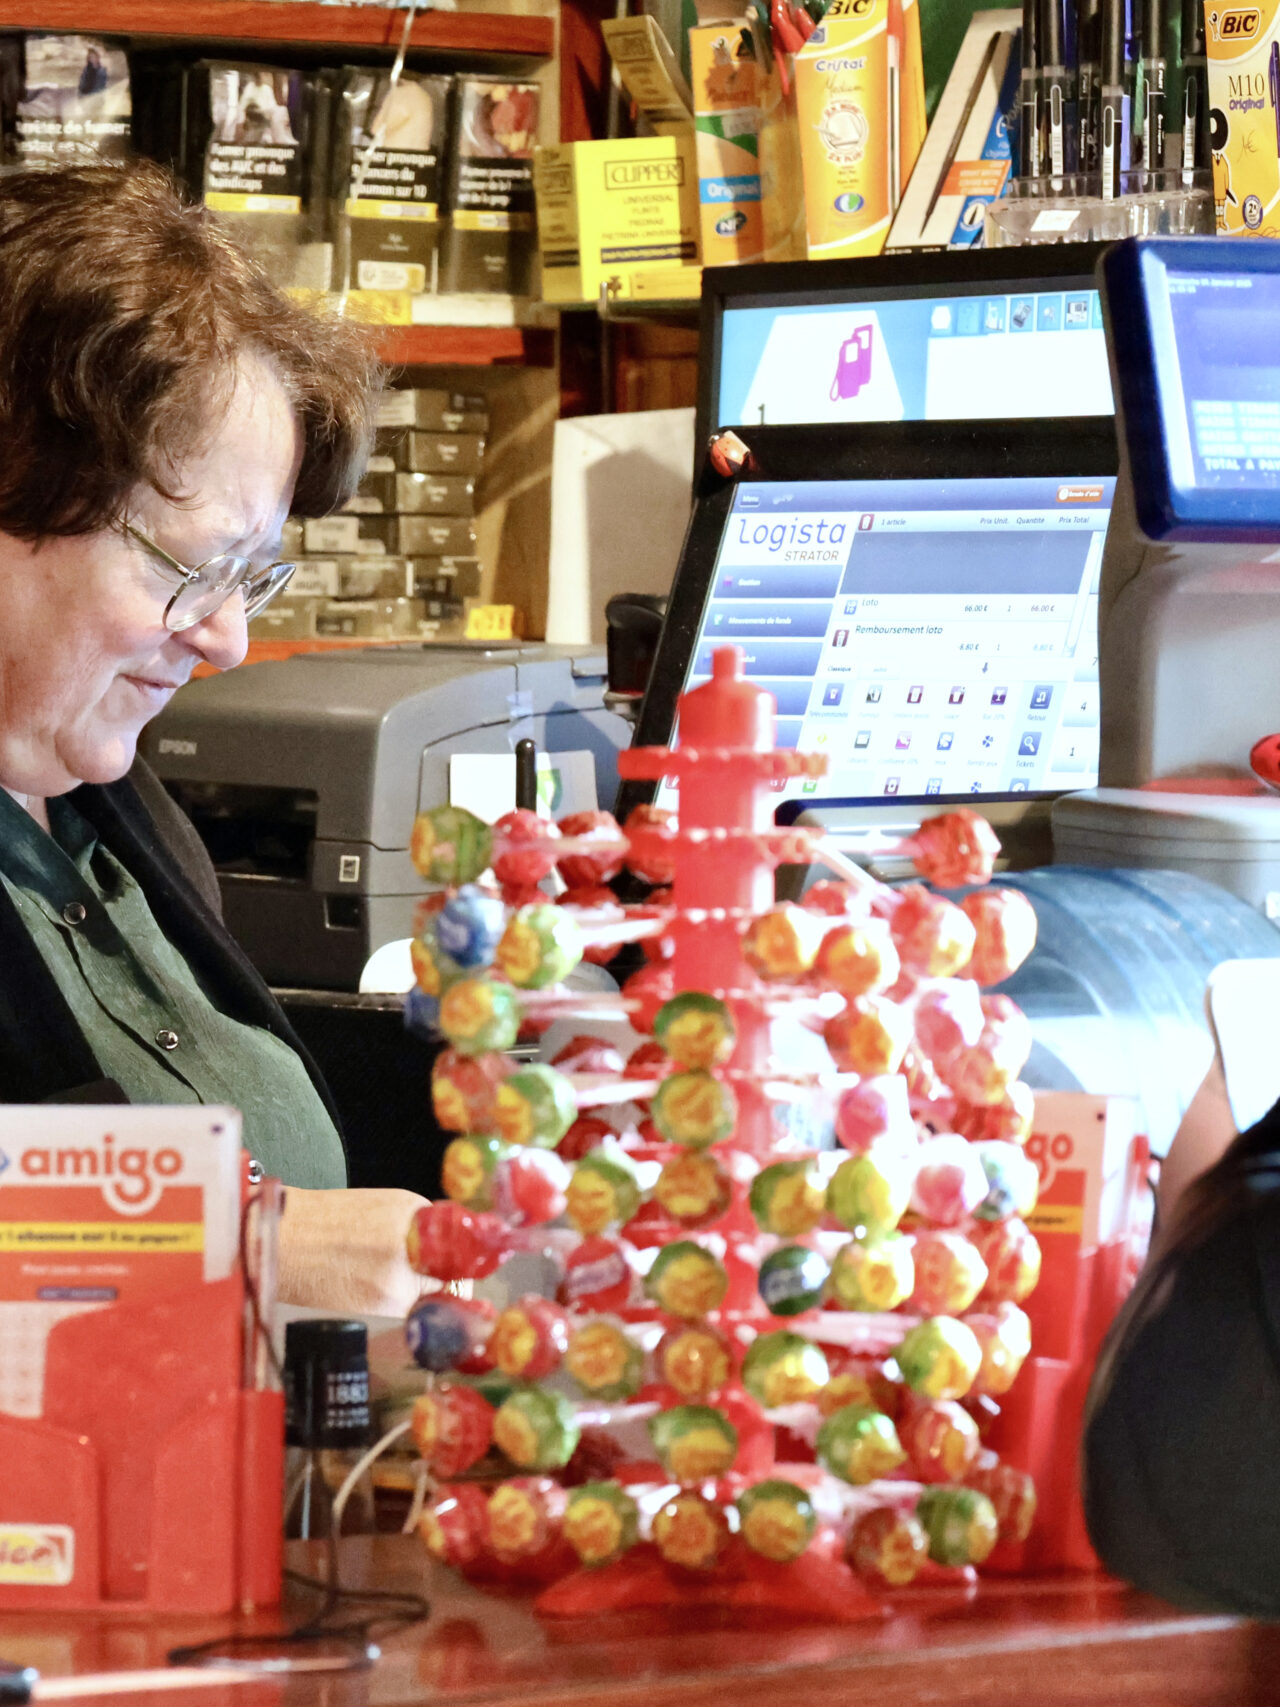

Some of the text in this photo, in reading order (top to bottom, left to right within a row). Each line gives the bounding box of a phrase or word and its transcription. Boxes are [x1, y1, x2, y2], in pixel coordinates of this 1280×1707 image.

[815, 58, 865, 72] Cristal
[1228, 72, 1265, 97] M10
[1229, 98, 1265, 114] Original
[211, 143, 295, 161] Fumer provoque
[210, 158, 286, 175] des AVC et des
[386, 152, 436, 168] provoque
[400, 166, 415, 181] du
[611, 164, 680, 184] CLIPPER
[209, 174, 263, 192] handicaps
[395, 184, 427, 198] sur 10
[1205, 458, 1240, 471] TOTAL
[1245, 459, 1255, 470] A
[888, 517, 907, 526] article
[980, 517, 993, 525] Prix
[1058, 517, 1072, 525] Prix
[1073, 517, 1090, 525] Total
[784, 550, 839, 561] STRATOR
[861, 599, 879, 608] Loto
[766, 617, 775, 625] de
[855, 625, 944, 635] Remboursement loto
[1081, 702, 1087, 711] 4
[158, 739, 198, 757] EPSON
[1069, 747, 1075, 757] 1
[1016, 760, 1035, 769] Tickets
[20, 1133, 184, 1204] amigo
